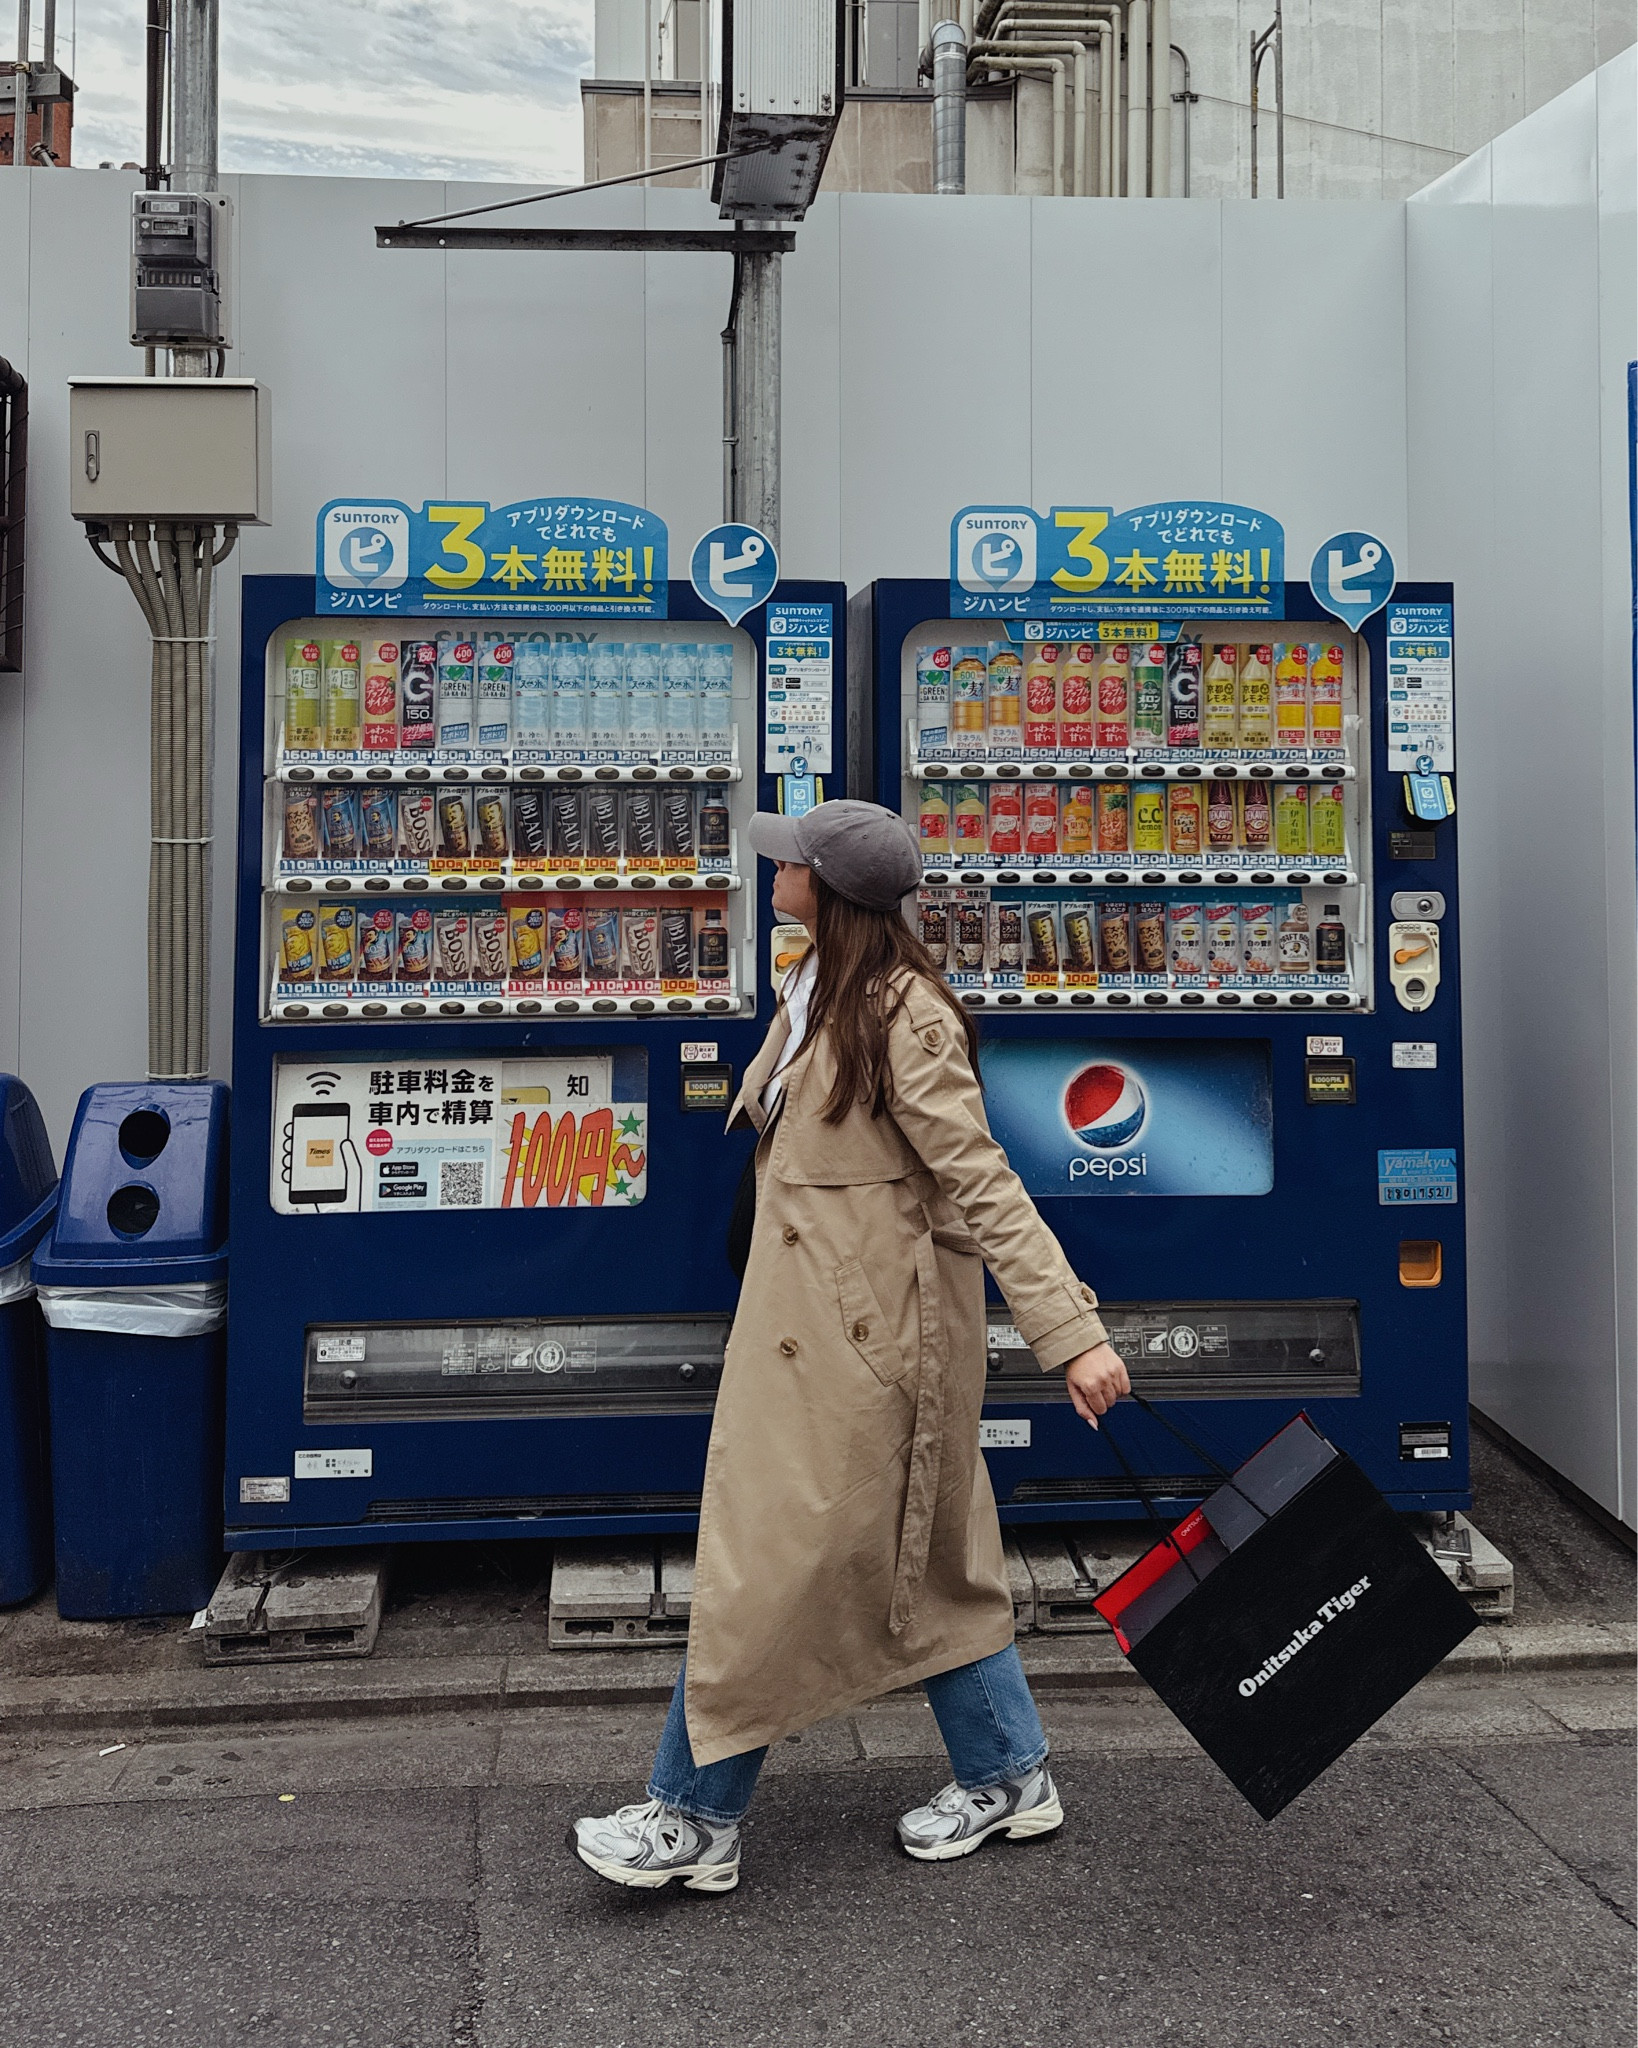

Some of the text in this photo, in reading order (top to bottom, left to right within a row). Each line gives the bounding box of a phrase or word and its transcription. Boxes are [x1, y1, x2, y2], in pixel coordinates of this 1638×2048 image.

[333, 512, 400, 524] SUNTORY
[506, 505, 646, 530] アプリダウンロード
[966, 519, 1028, 530] SUNTORY
[1129, 508, 1262, 532] アプリダウンロード
[536, 523, 617, 543] でどれでも
[1157, 527, 1235, 545] でどれでも
[350, 533, 386, 572] ピ
[423, 506, 655, 593] 3本無料!
[982, 539, 1016, 577] ピ
[1050, 511, 1271, 594] 3本無料!
[709, 535, 765, 598] ピ
[1328, 542, 1382, 604] ピ
[330, 591, 402, 609] ジハンピ
[962, 596, 1031, 612] ジハンピ
[775, 607, 824, 616] SUNTORY
[1395, 607, 1443, 616] SUNTORY
[788, 623, 829, 634] ジハンピ
[1045, 627, 1093, 639] ジハンピ
[1102, 627, 1153, 639] 3本無料!
[1408, 623, 1449, 634] ジハンピ
[455, 649, 472, 658] 600
[495, 650, 512, 659] 600
[934, 654, 950, 664] 600
[960, 671, 975, 680] 600
[996, 666, 1012, 674] 600
[443, 683, 467, 691] GREEN
[482, 683, 506, 692] GREEN
[922, 687, 945, 695] GREEN
[1206, 684, 1224, 694] 京都
[1242, 684, 1260, 694] 京都
[406, 709, 430, 720] 150
[1174, 709, 1197, 719] 150
[370, 735, 388, 743] 甘い
[1034, 733, 1050, 741] 甘い
[1070, 733, 1086, 741] 甘い
[1105, 733, 1122, 741] 甘い
[1138, 808, 1162, 823] C.C.
[409, 806, 431, 851] BOSS
[520, 797, 545, 853] BLACK
[559, 797, 582, 853] BLACK
[595, 797, 619, 853] BLACK
[632, 797, 656, 853] BLACK
[669, 797, 692, 853] BLACK
[1138, 823, 1162, 831] Lemon
[1290, 809, 1300, 847] 伊右衛門
[1325, 809, 1336, 847] 伊右衛門
[633, 927, 655, 973] BOSS
[668, 915, 692, 974] BLACK
[1279, 933, 1299, 950] CRAFT
[445, 928, 467, 973] BOSS
[483, 928, 505, 973] BOSS
[368, 1068, 494, 1096] 駐車料金を
[566, 1074, 589, 1097] 知
[368, 1100, 493, 1126] 車内で精算
[396, 1145, 485, 1155] アプリダウンロードはこちら
[1069, 1152, 1147, 1181] pepsi
[1384, 1151, 1450, 1176] yamakyu
[393, 1183, 425, 1192] Google Play
[1238, 1575, 1372, 1698] Onitsuka Tiger
[972, 1792, 996, 1814] N
